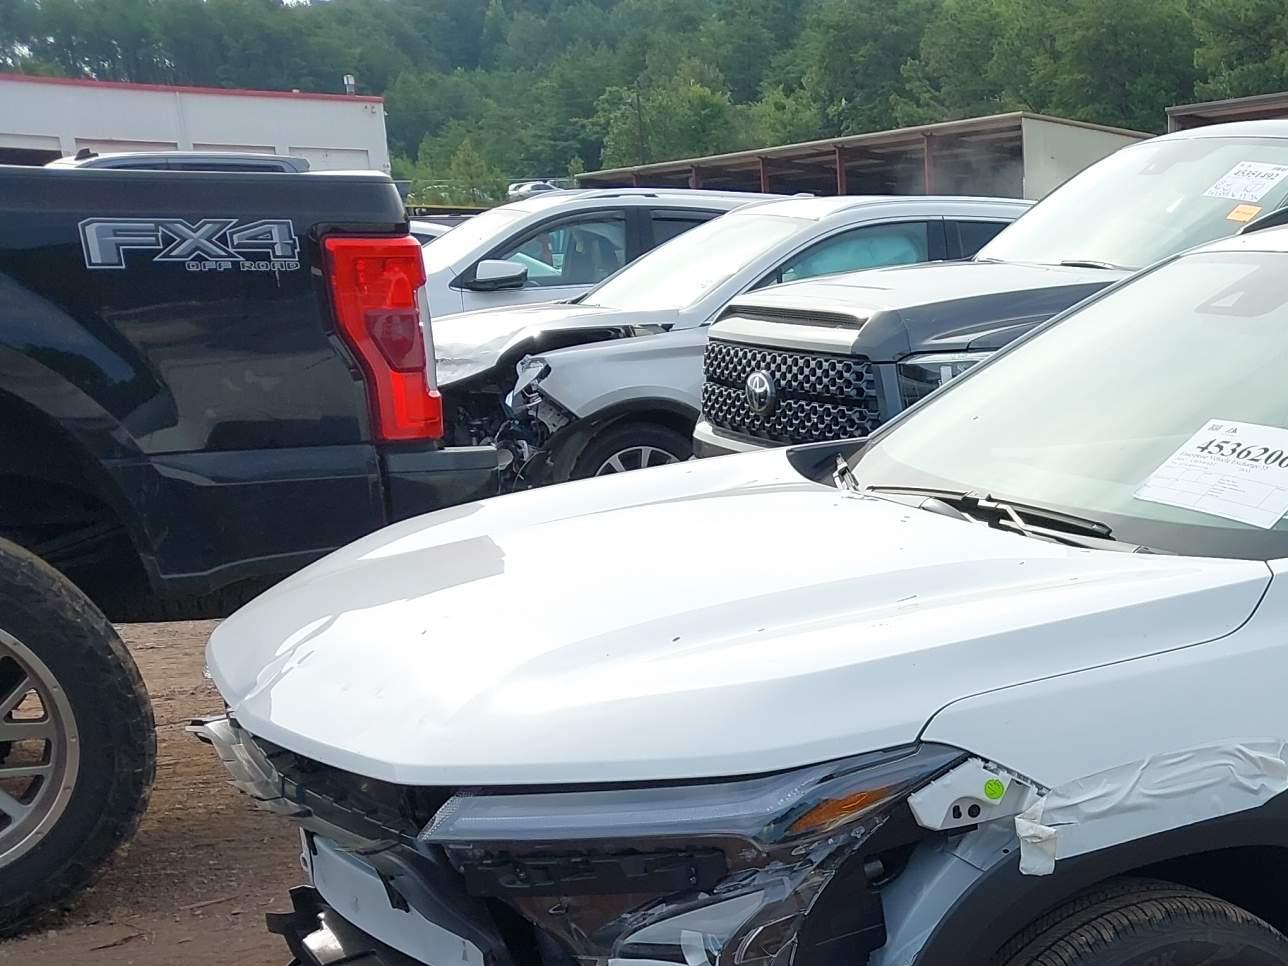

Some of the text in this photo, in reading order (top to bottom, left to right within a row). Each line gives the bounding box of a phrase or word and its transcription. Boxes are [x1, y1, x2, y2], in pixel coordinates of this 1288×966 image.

[77, 217, 300, 269] FX4
[185, 261, 300, 271] OFF ROAD
